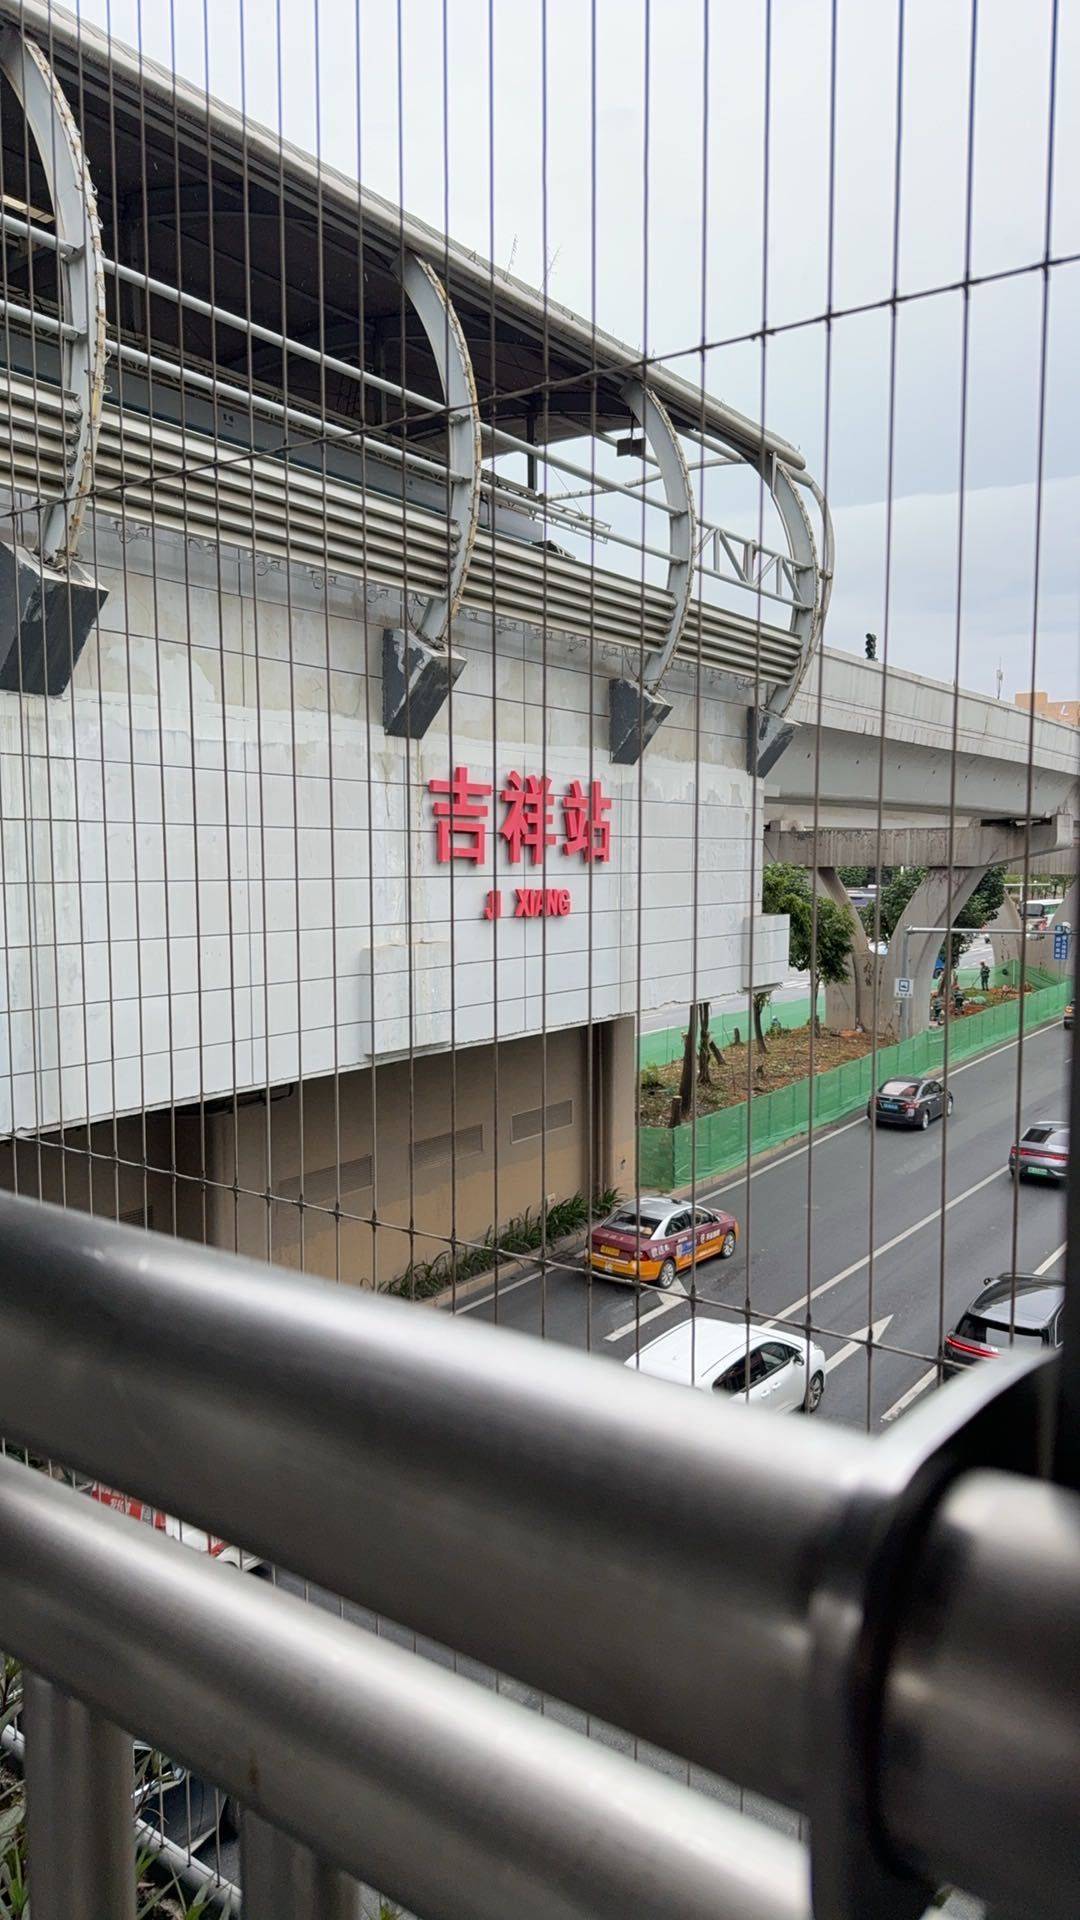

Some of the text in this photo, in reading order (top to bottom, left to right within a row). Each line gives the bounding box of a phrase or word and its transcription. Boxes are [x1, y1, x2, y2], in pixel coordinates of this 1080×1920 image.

[428, 766, 612, 865] 吉祥站
[515, 888, 571, 917] XIANG
